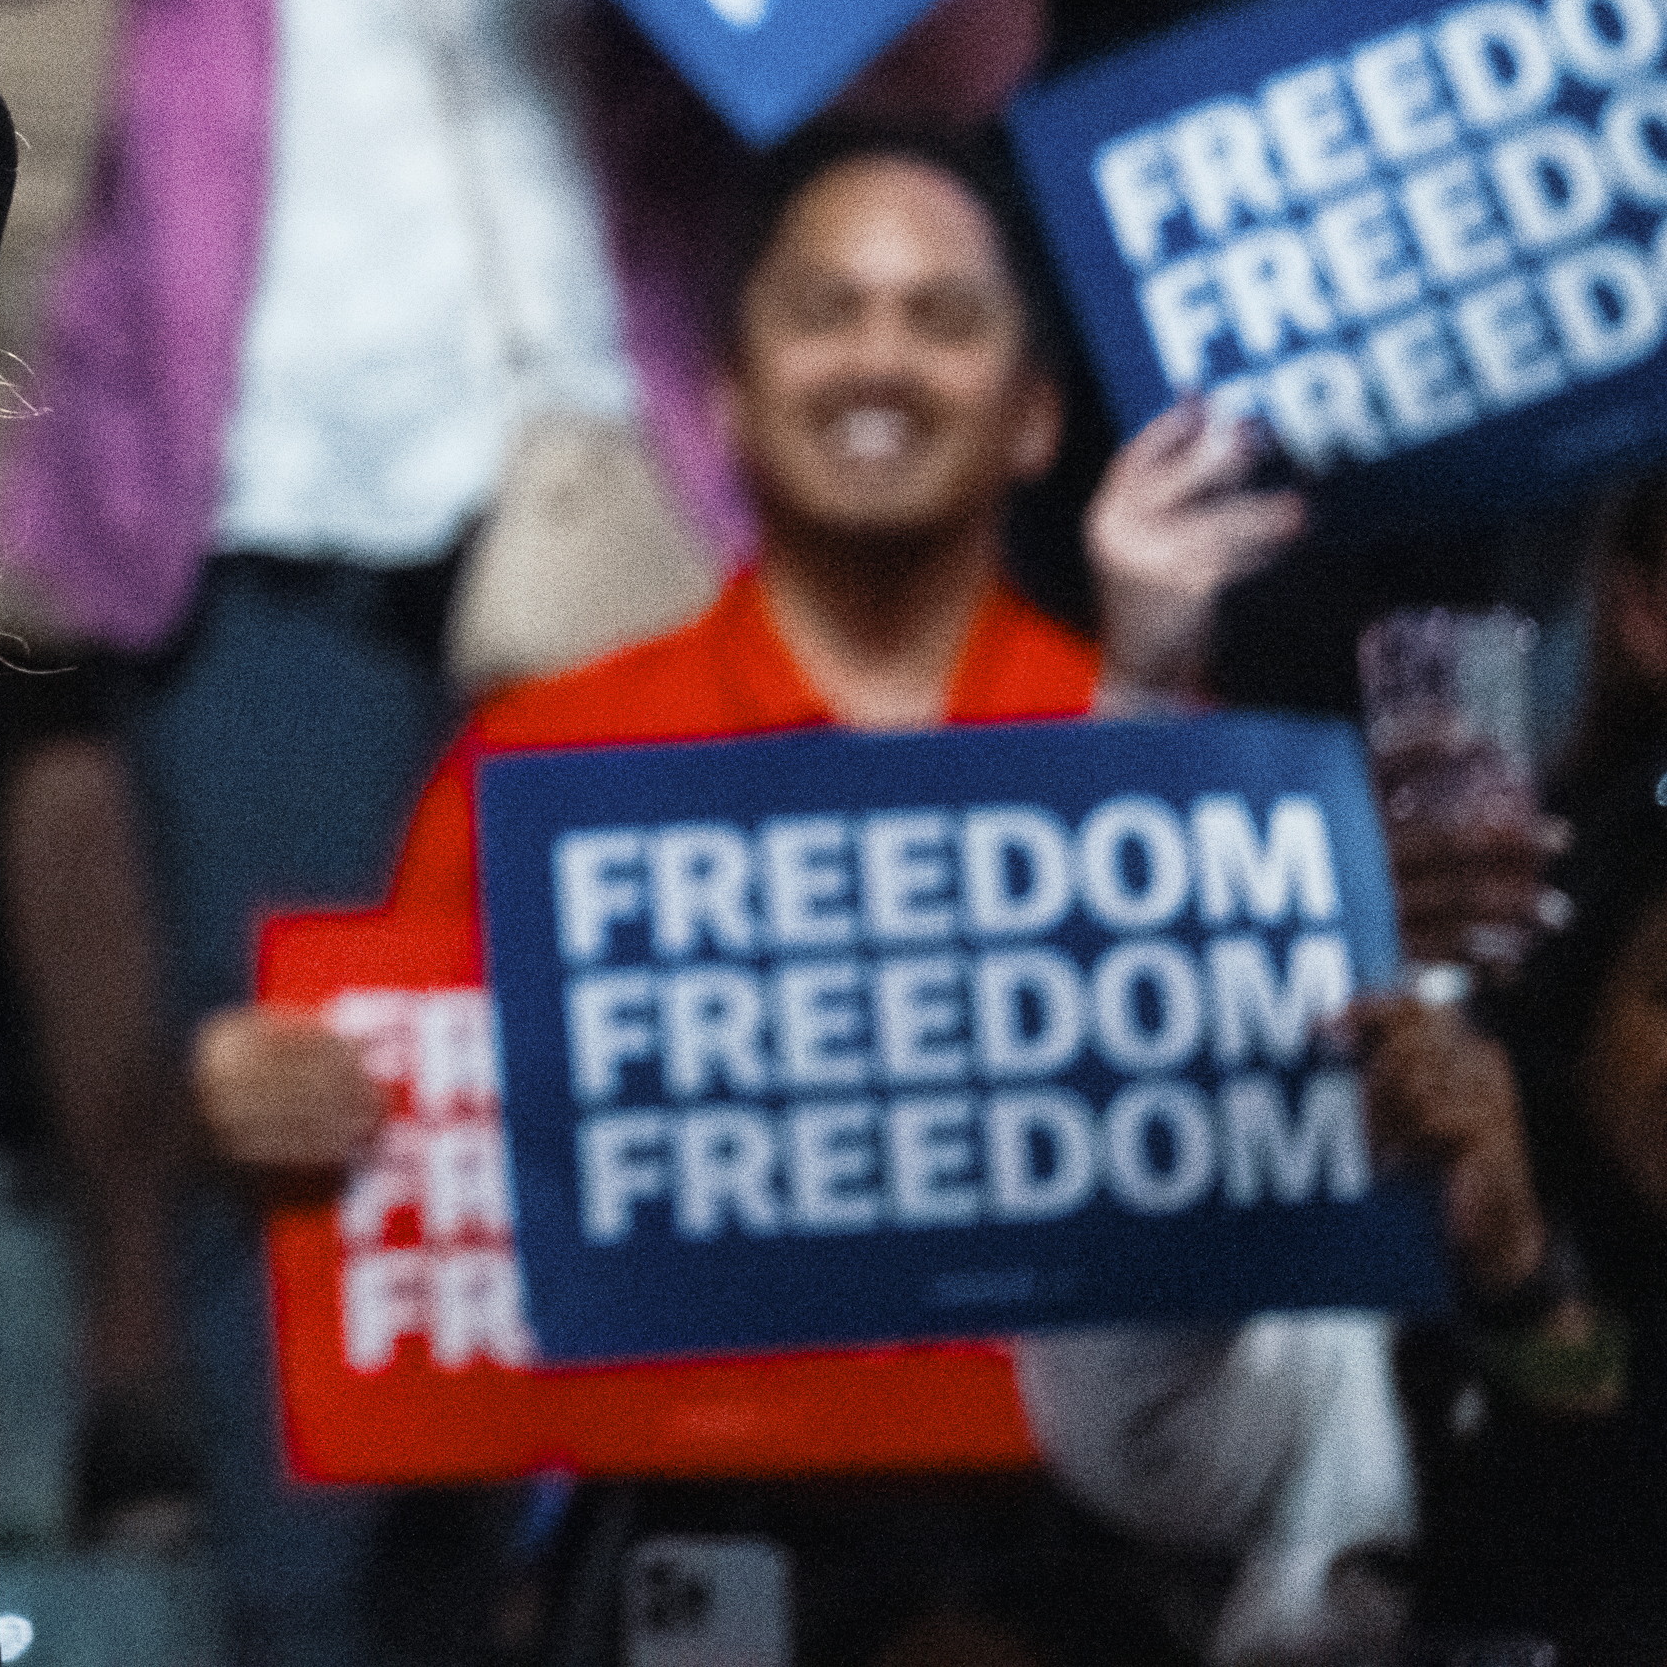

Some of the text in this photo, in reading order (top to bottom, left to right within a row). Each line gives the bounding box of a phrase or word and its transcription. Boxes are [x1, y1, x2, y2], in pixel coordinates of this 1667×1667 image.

[552, 794, 1338, 963] FREEDOM
[565, 932, 1352, 1103] FREEDOM
[578, 1075, 1371, 1244] FREEDOM
